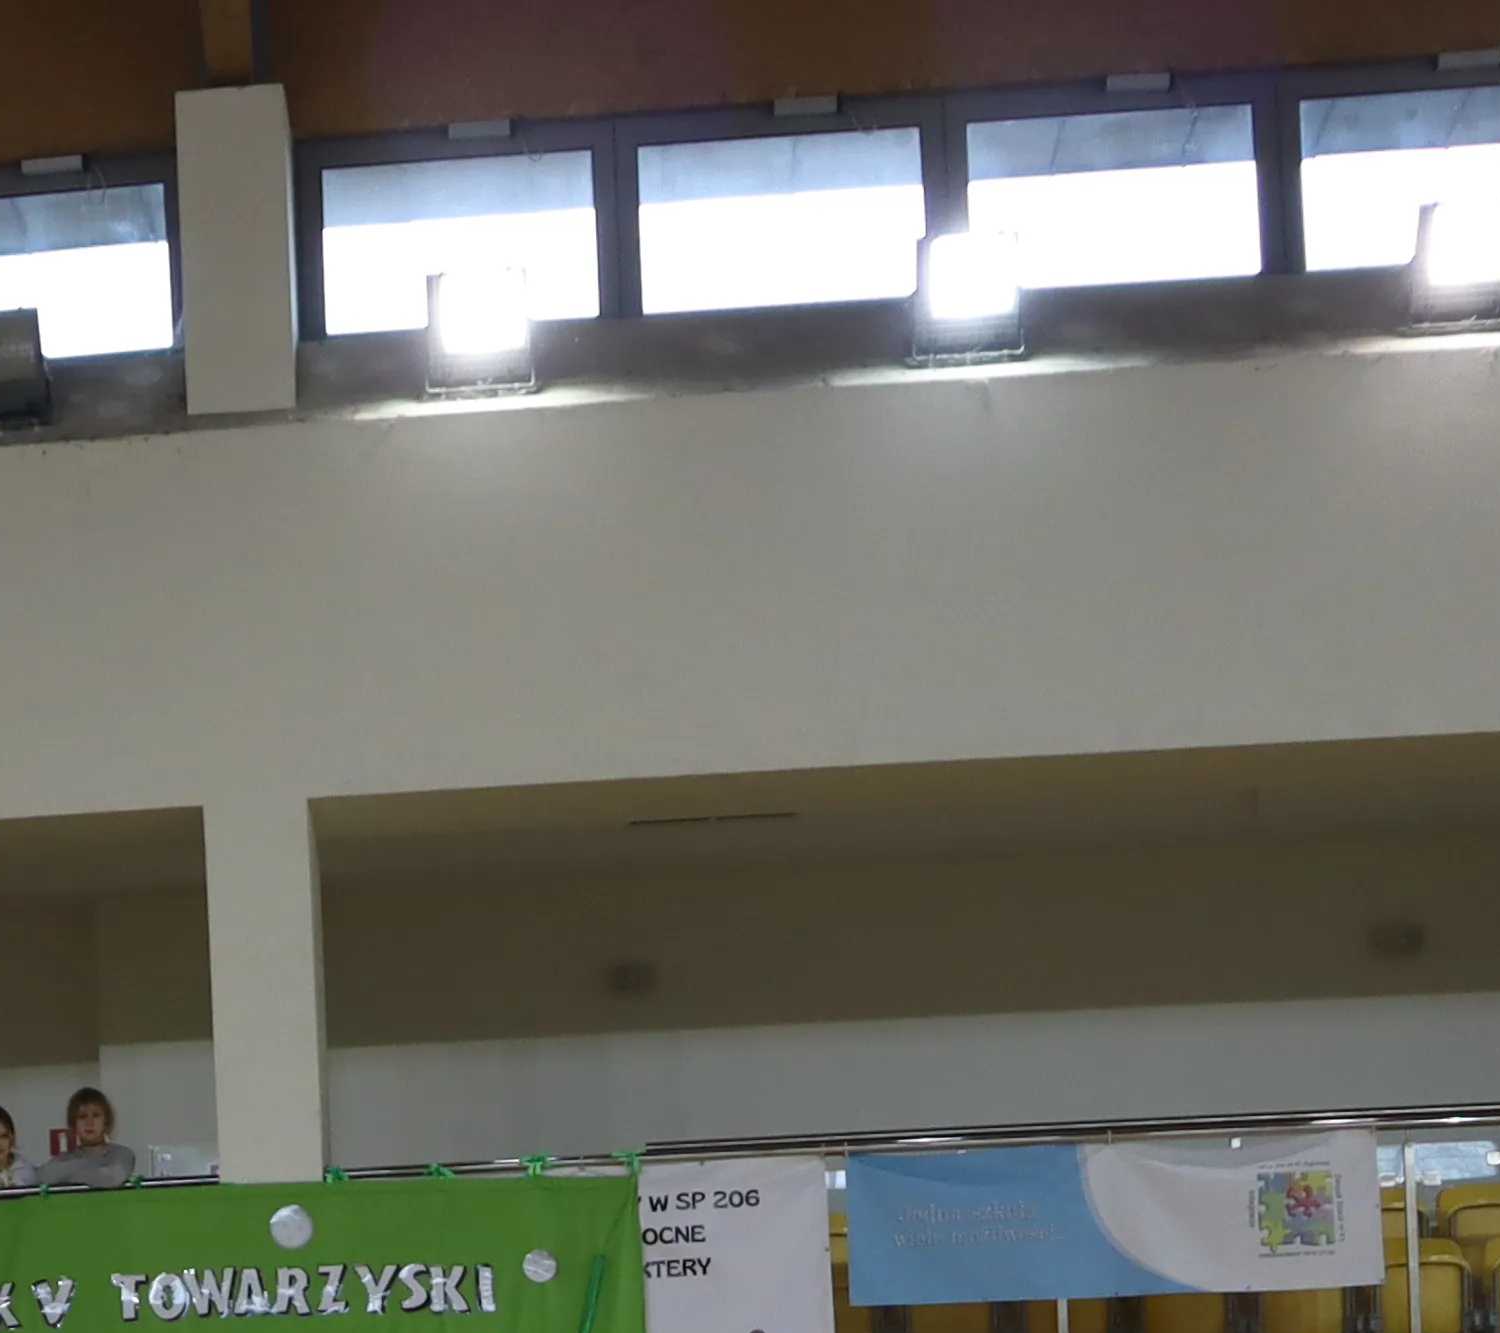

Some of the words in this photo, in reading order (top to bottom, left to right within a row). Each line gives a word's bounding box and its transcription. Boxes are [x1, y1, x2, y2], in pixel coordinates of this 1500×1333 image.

[648, 1194, 669, 1213] W
[675, 1191, 706, 1211] SP
[713, 1188, 761, 1209] 206
[641, 1224, 707, 1246] OCNE
[643, 1257, 712, 1279] KTERY
[110, 1262, 497, 1322] TOWARZYSKI
